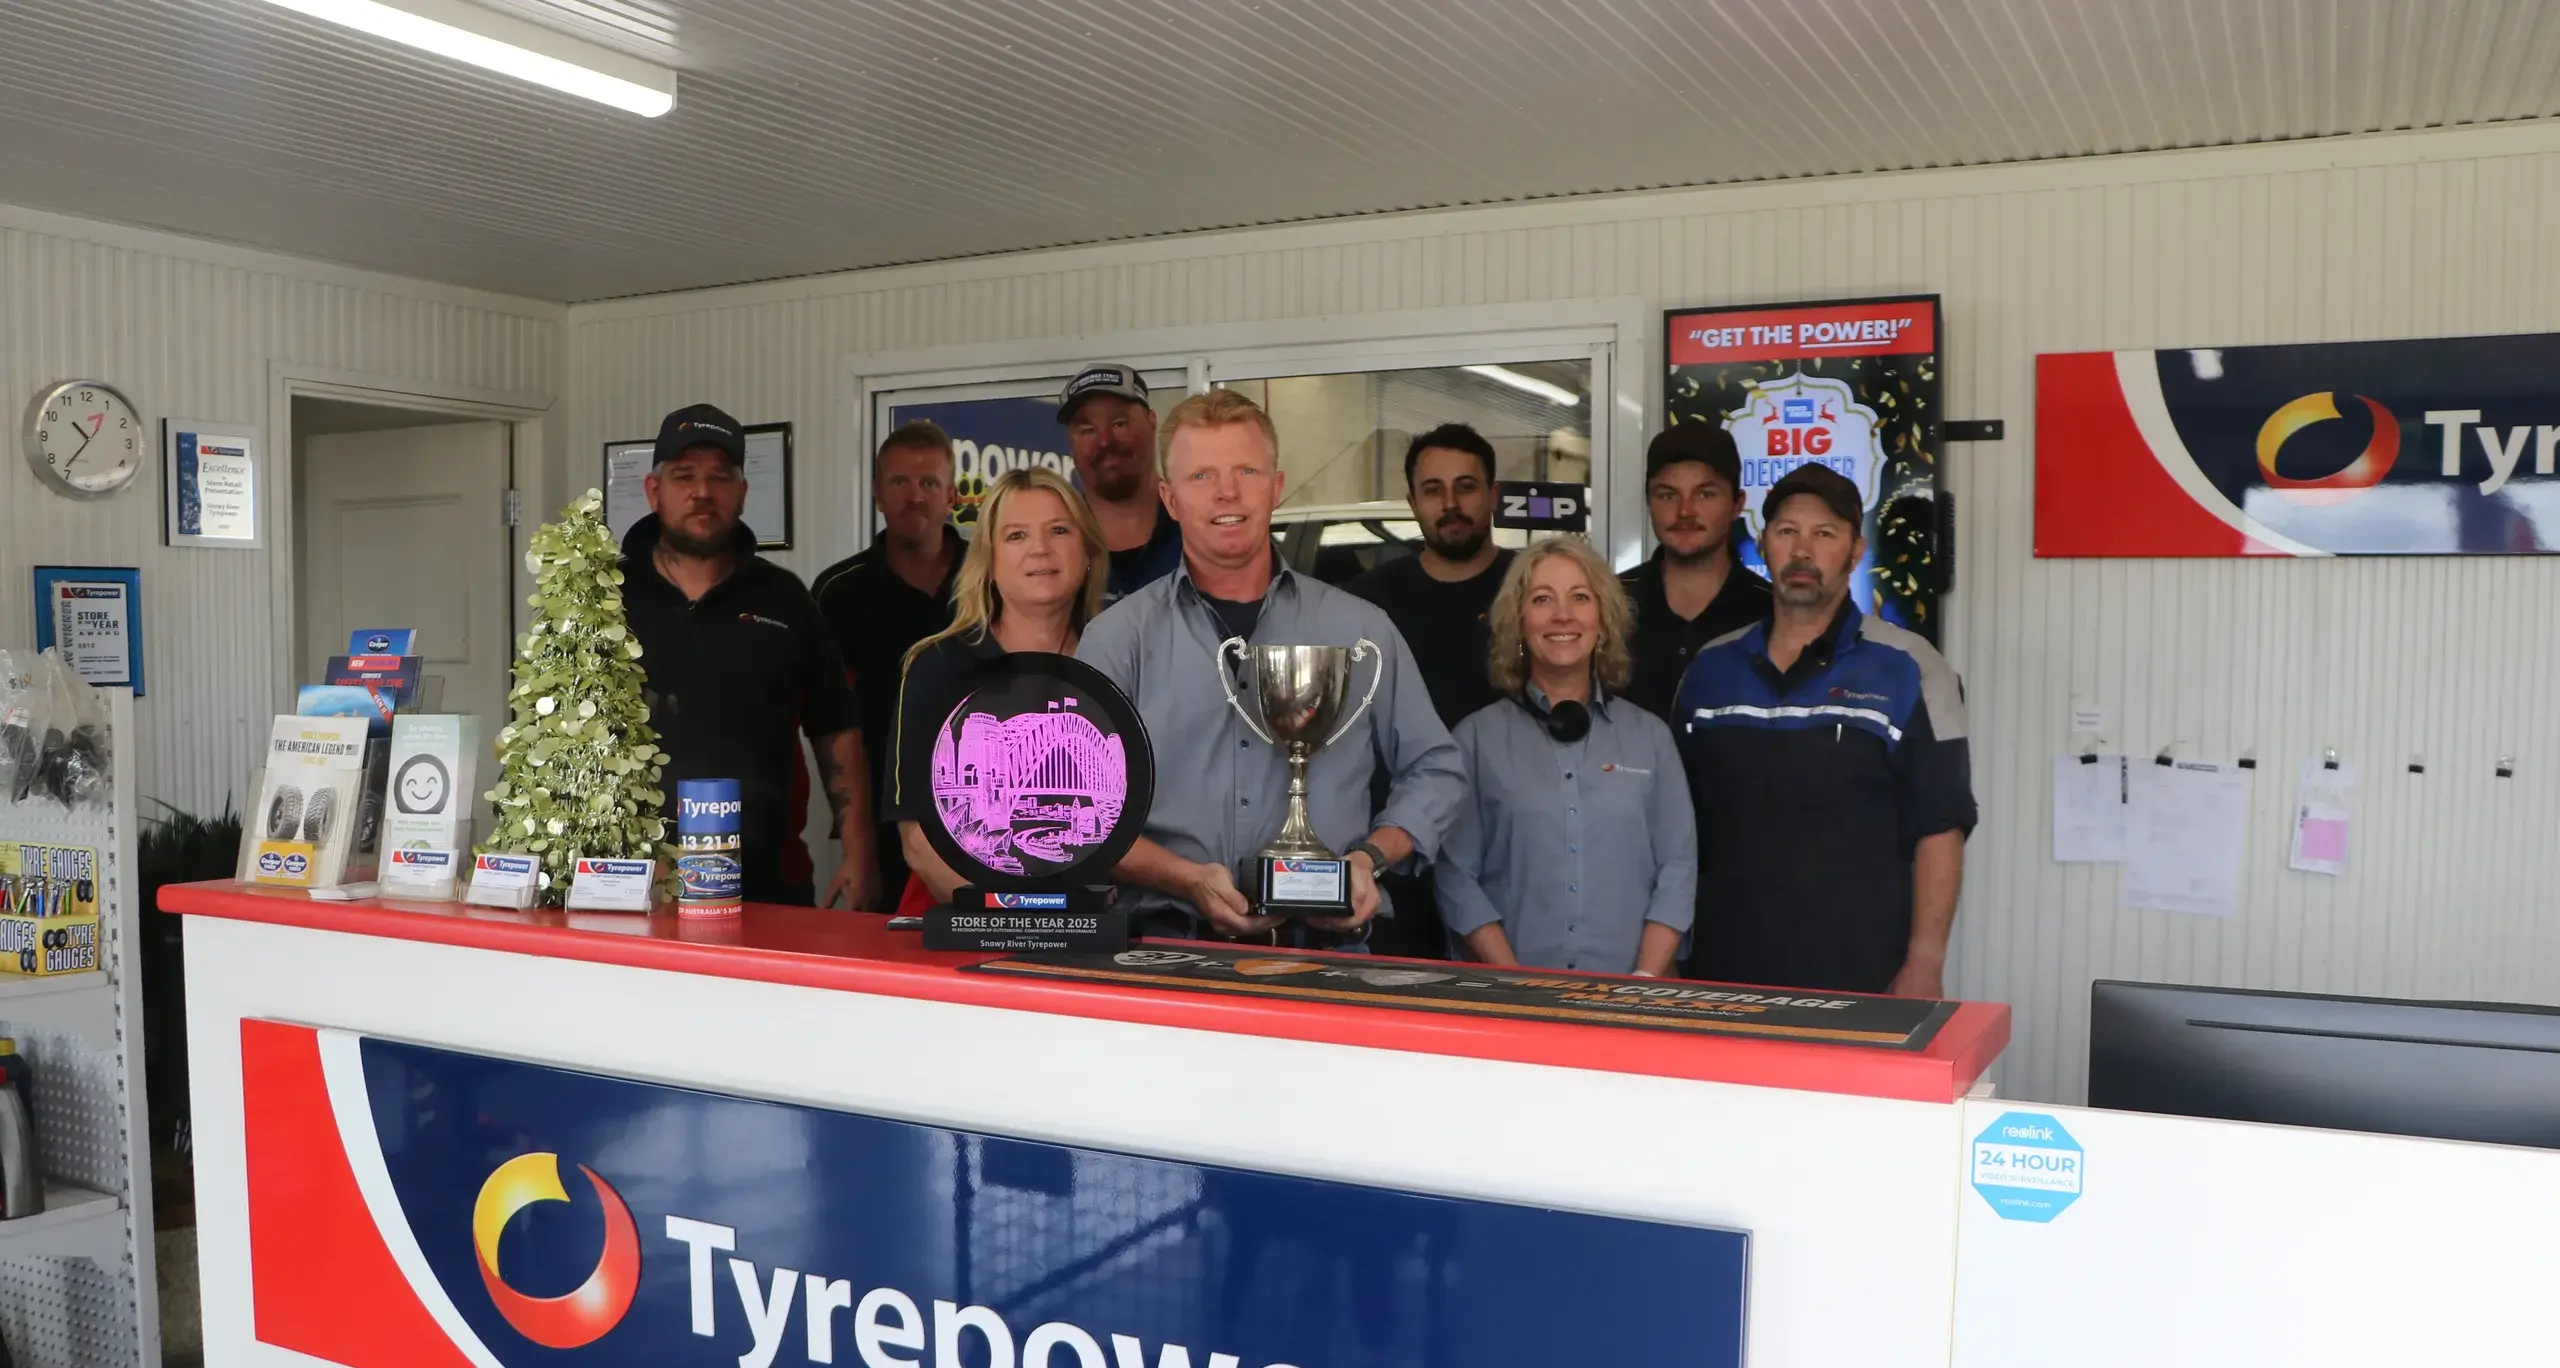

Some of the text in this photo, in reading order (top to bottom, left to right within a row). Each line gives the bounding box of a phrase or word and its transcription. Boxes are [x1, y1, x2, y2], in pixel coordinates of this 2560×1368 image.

[1750, 325, 1792, 345] THE
[61, 395, 72, 406] 11
[80, 391, 93, 402] 12
[105, 400, 110, 410] 1
[46, 411, 58, 422] 10
[120, 418, 127, 428] 2
[40, 430, 48, 442] 9
[1767, 427, 1832, 456] BIG
[125, 438, 133, 449] 3
[2424, 409, 2560, 496] Tyr
[47, 453, 56, 464] 8
[64, 469, 71, 480] 7
[205, 487, 243, 495] Presentation
[86, 589, 119, 597] Tyrepower
[78, 612, 108, 620] STORE
[92, 620, 119, 629] YEAR
[368, 640, 389, 649] Cooper
[275, 740, 345, 755] THE AMERICAN LEGEND
[682, 835, 698, 850] 13
[702, 835, 722, 850] 21
[20, 845, 92, 880] TYRE GAUGES
[417, 854, 446, 863] Tyrepower
[500, 860, 529, 870] Tyrepower
[607, 864, 643, 873] Tyrepower
[1302, 863, 1336, 871] Tyrepower
[1019, 895, 1065, 906] Tyrepower
[951, 917, 1097, 929] STORE OF THE YEAR 2025
[67, 924, 96, 946] TYRE
[980, 940, 1067, 950] Snowy River Tyrepower
[46, 946, 96, 973] GAUGES
[2002, 1124, 2054, 1141] reolink
[1980, 1150, 2076, 1173] 24 HOUR
[1980, 1172, 2075, 1188] VIDEO SURVEILLANCE
[2001, 1198, 2051, 1209] reolink.com
[665, 1214, 1301, 1368] Tyrepo
